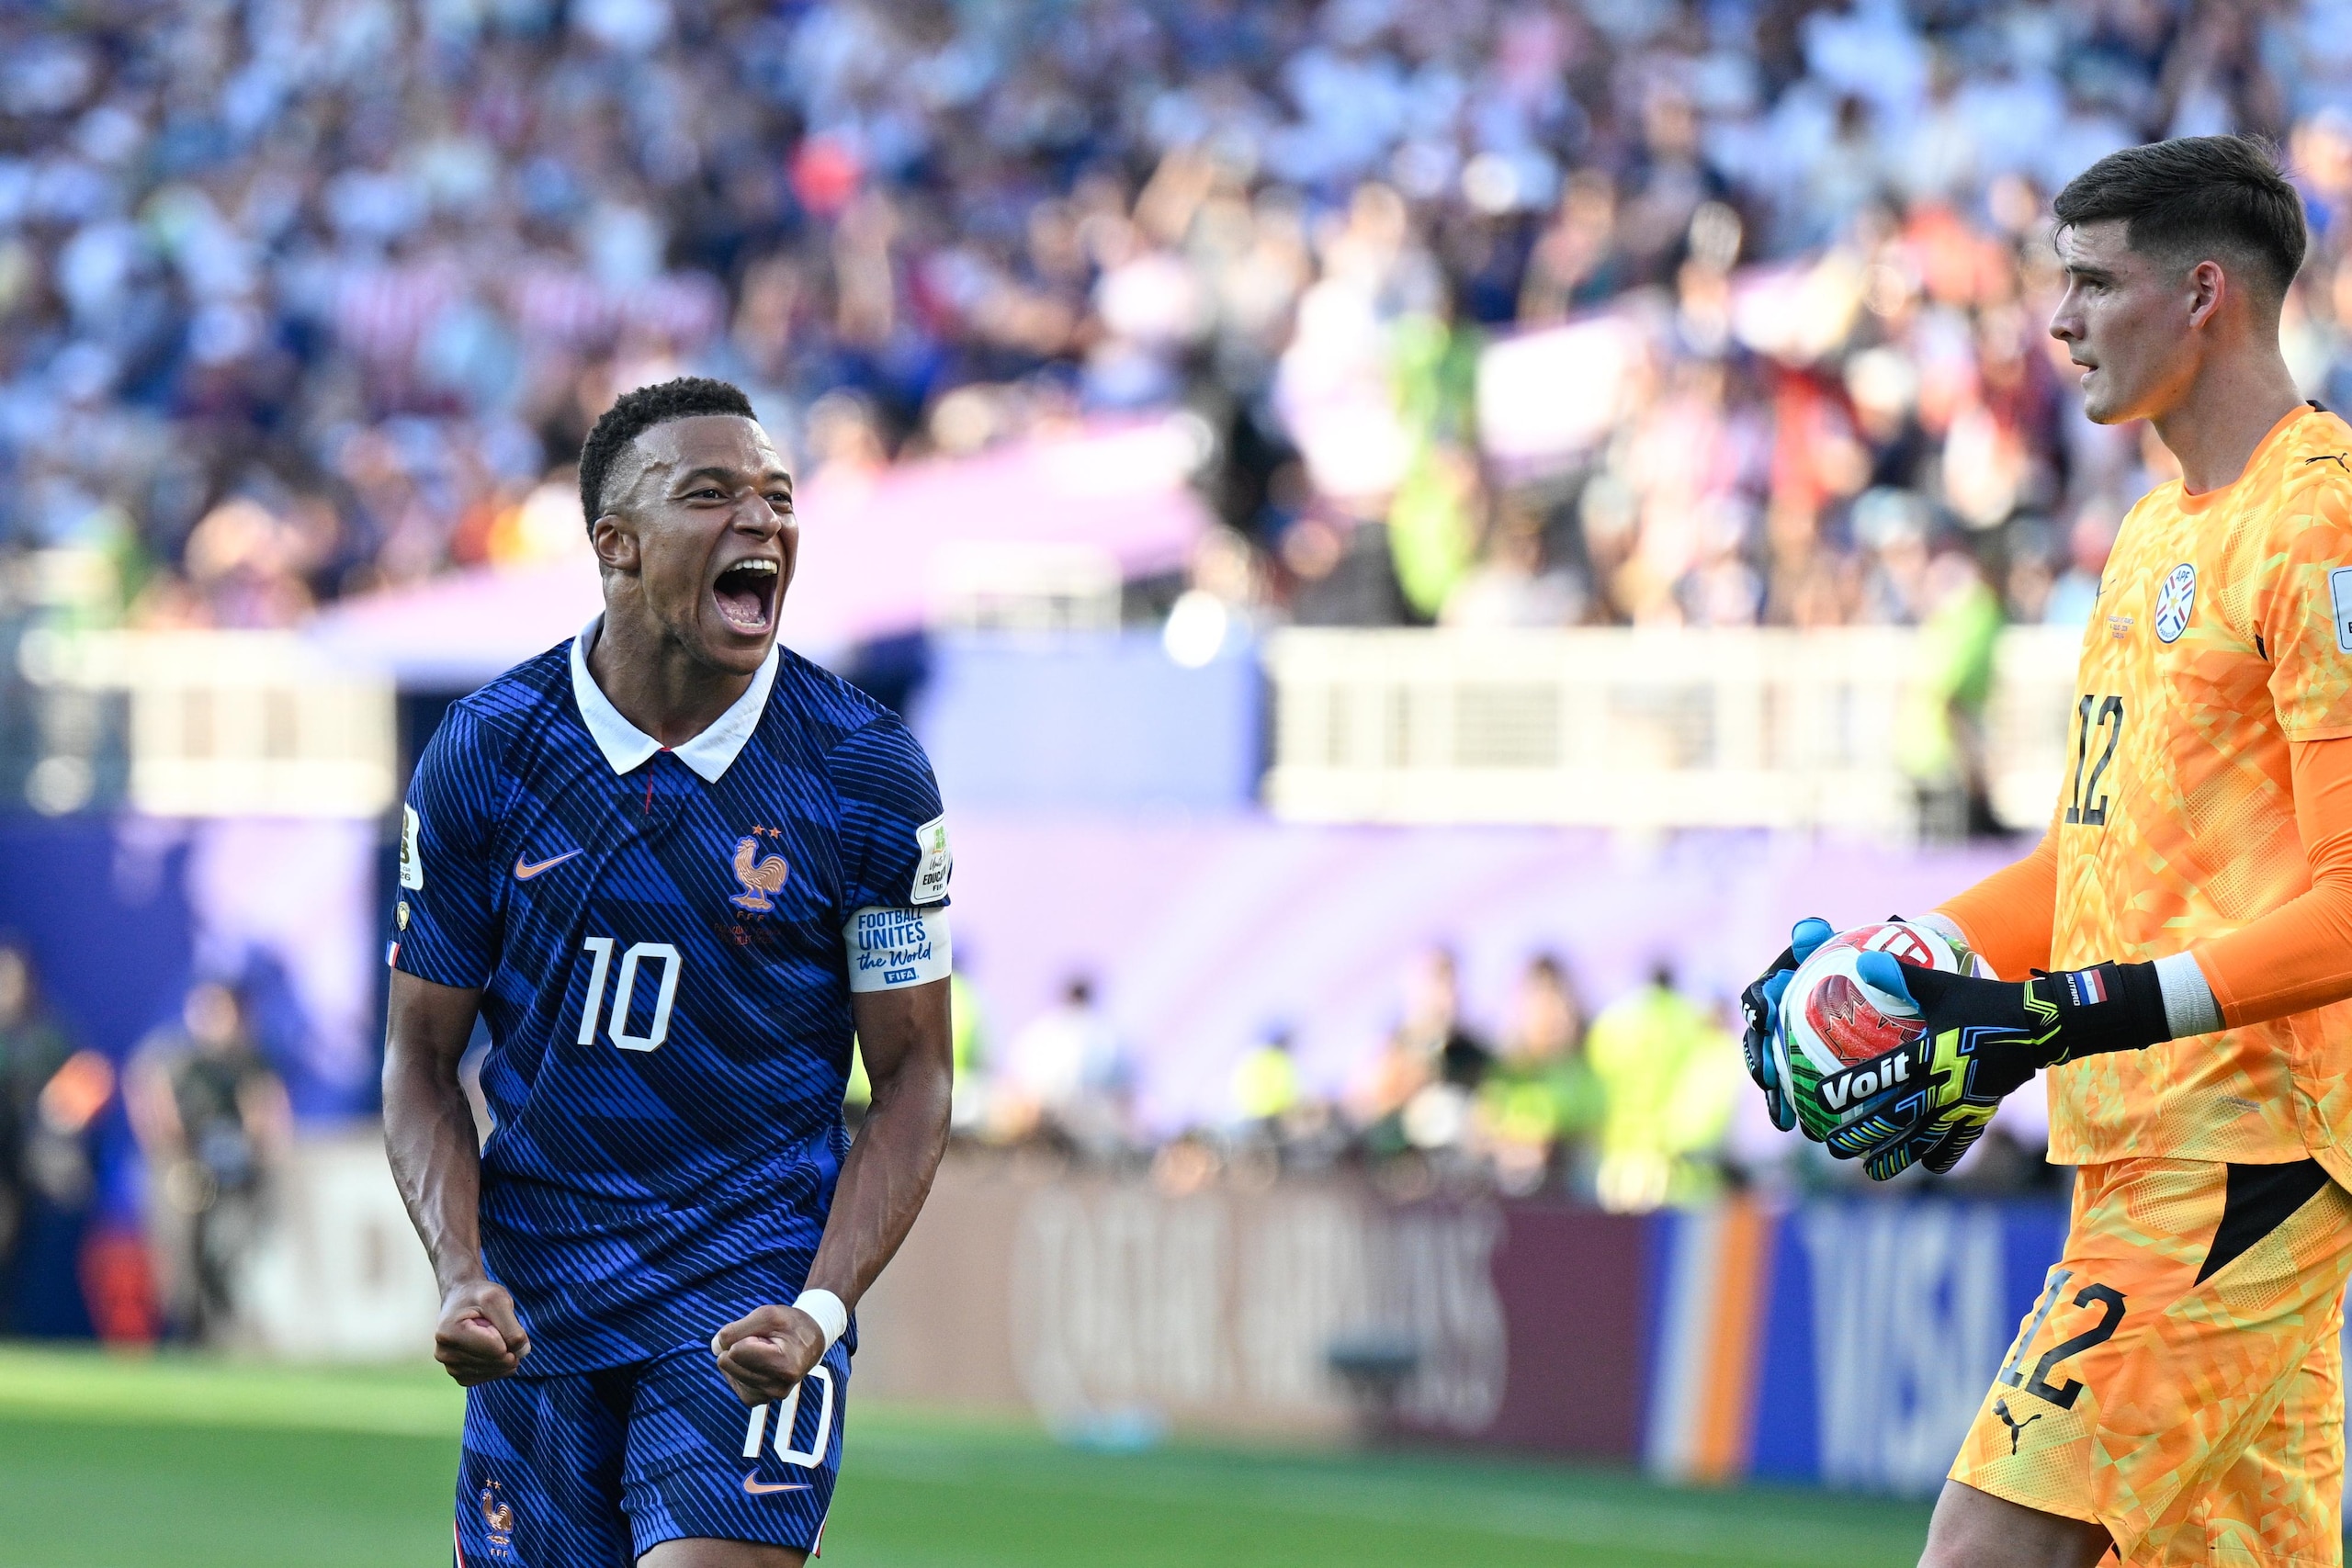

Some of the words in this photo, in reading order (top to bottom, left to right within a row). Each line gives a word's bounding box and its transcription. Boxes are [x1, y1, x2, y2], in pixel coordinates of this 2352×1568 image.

[2176, 570, 2190, 582] APF
[2064, 694, 2124, 826] 12
[858, 907, 922, 930] FOOTBALL
[858, 920, 926, 951] UNITES
[856, 952, 887, 970] the
[889, 942, 932, 967] World
[887, 969, 915, 983] FIFA
[2065, 973, 2081, 1007] LAUTARO
[577, 937, 683, 1053] 10
[1822, 1052, 1909, 1110] Voit
[1998, 1269, 2128, 1410] 12
[490, 1548, 508, 1558] FFF
